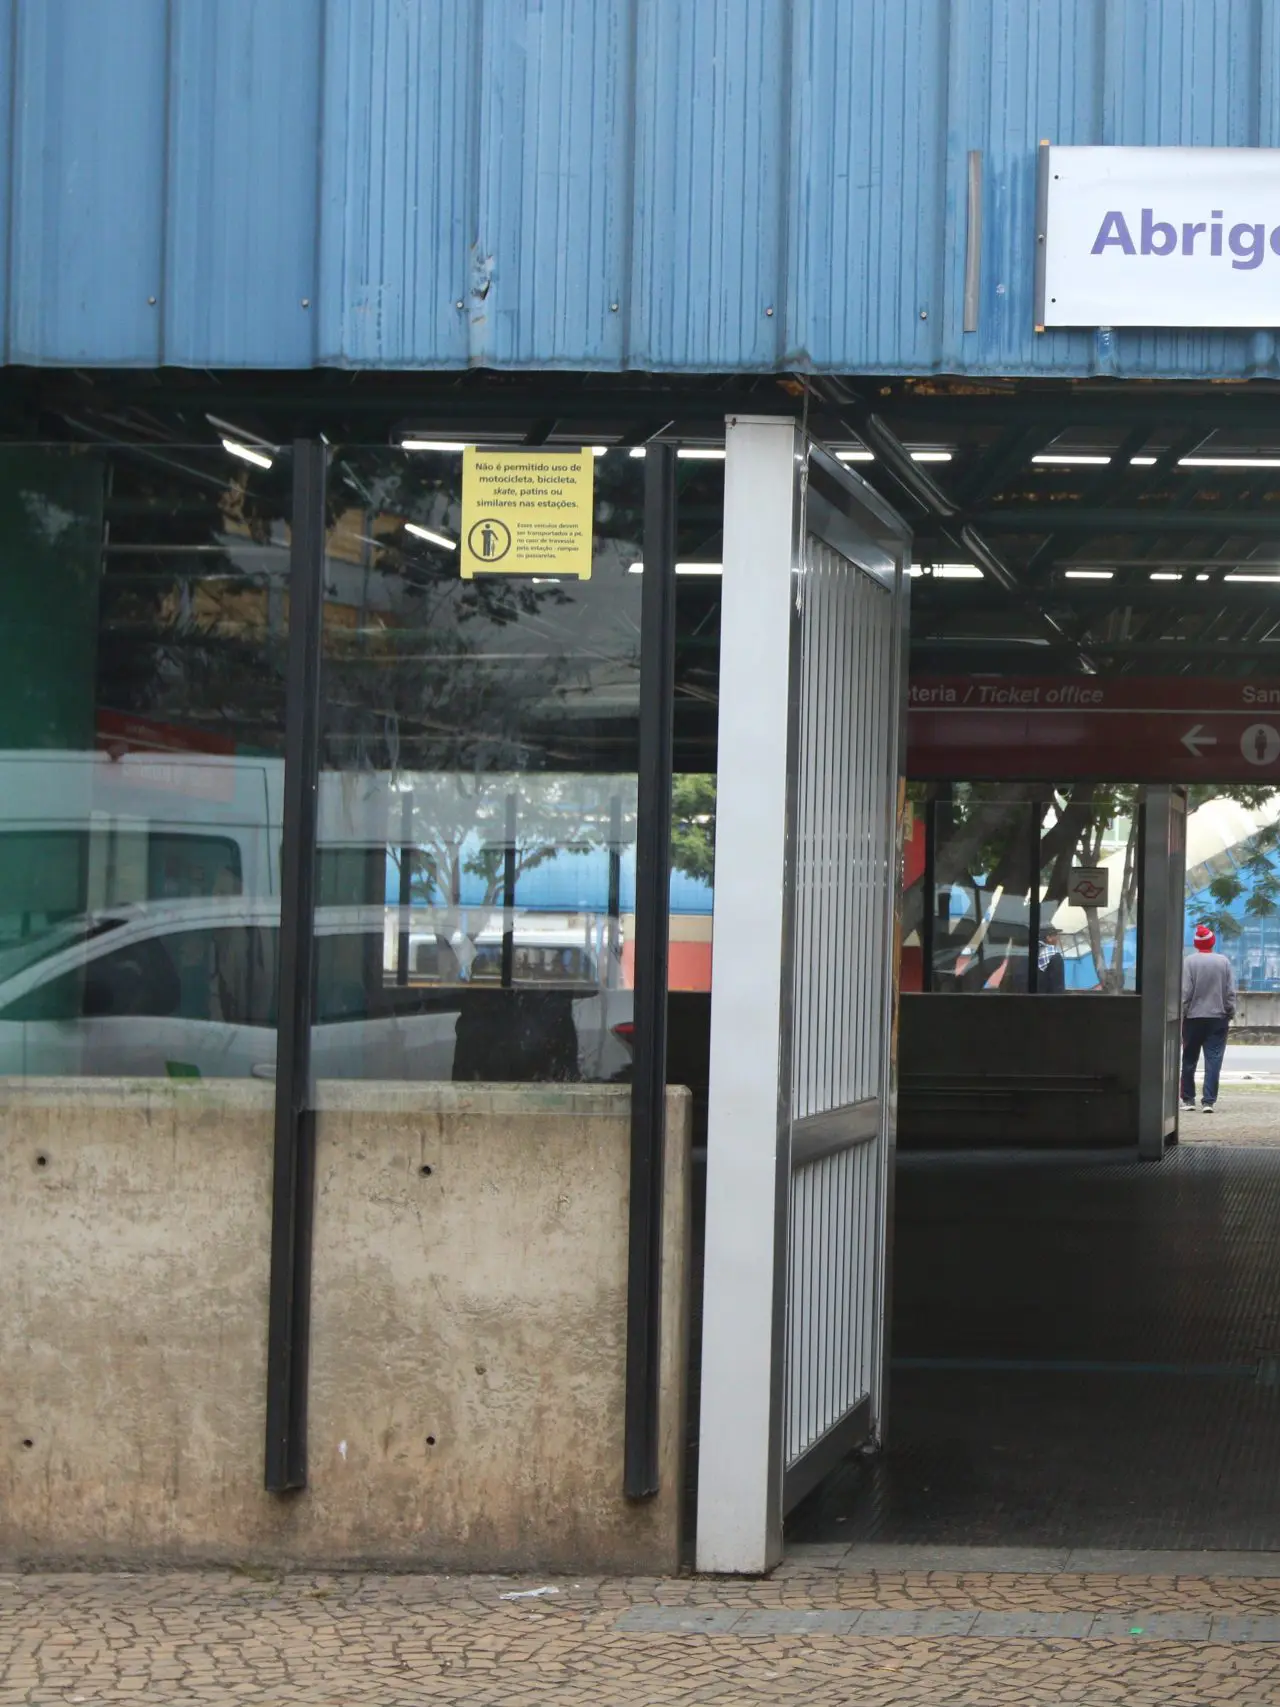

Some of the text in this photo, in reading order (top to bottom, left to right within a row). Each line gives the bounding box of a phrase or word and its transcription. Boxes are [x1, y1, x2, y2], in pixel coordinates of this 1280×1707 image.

[475, 463, 494, 471] Não
[496, 463, 501, 471] é
[503, 463, 549, 473] permitido
[570, 464, 582, 472] de
[479, 475, 577, 484] motocicleta, bicicleta,
[493, 488, 517, 496] skate,
[520, 488, 548, 496] patins
[476, 499, 517, 507] similares
[537, 500, 579, 510] estações.
[908, 684, 1104, 704] teria / Ticket office
